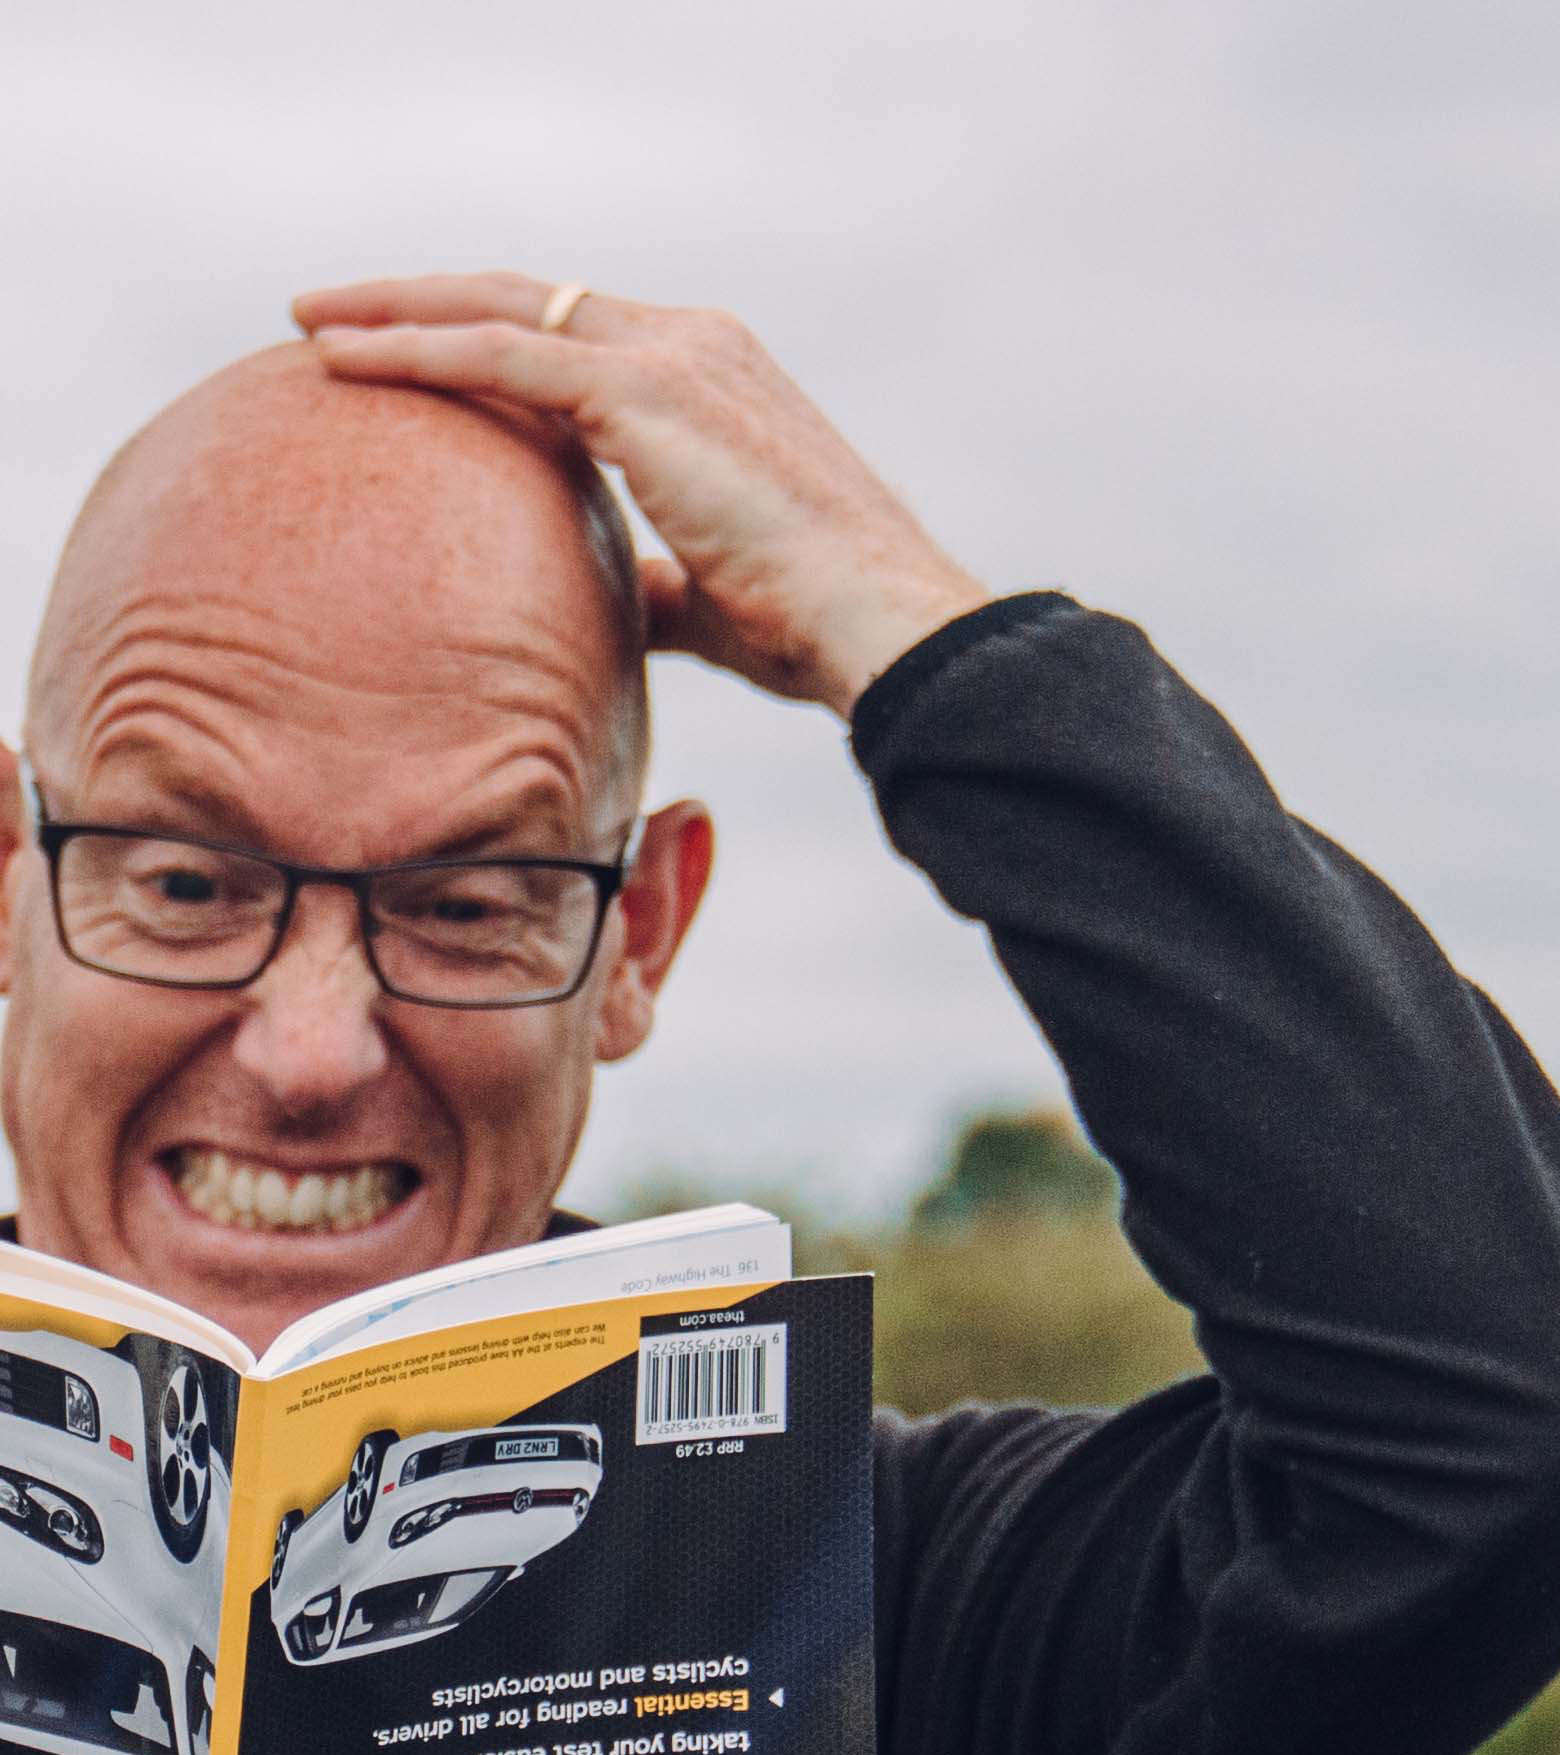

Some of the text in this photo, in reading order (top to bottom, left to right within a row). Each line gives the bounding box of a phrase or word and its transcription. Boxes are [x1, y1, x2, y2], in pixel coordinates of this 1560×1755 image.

[620, 1259, 758, 1295] 136 The Highway Code
[679, 1310, 744, 1328] theaa.com
[553, 1328, 572, 1339] also
[574, 1325, 590, 1335] can
[593, 1323, 606, 1333] We
[482, 1336, 509, 1350] driving
[512, 1335, 530, 1346] with
[532, 1331, 551, 1343] help
[590, 1335, 605, 1345] The
[772, 1332, 780, 1345] 9
[543, 1343, 552, 1352] at
[555, 1337, 587, 1350] experts
[431, 1351, 446, 1361] and
[449, 1344, 479, 1357] lessons
[491, 1350, 509, 1361] have
[512, 1349, 524, 1357] AA
[527, 1345, 540, 1355] the
[392, 1361, 402, 1370] on
[404, 1354, 429, 1366] advice
[448, 1353, 487, 1370] produced
[365, 1362, 390, 1377] buying
[410, 1365, 429, 1377] book
[431, 1362, 446, 1373] this
[349, 1372, 363, 1383] and
[364, 1377, 377, 1388] you
[379, 1373, 396, 1384] help
[399, 1372, 407, 1381] to
[321, 1376, 347, 1390] running
[345, 1381, 362, 1393] pass
[327, 1387, 343, 1400] your
[302, 1394, 325, 1409] driving
[753, 1413, 778, 1425] ISBN
[495, 1440, 556, 1458] LRN2 DRV
[675, 1439, 744, 1458] RRP £2.49
[431, 1657, 749, 1708] cyclists and motorcyclists
[372, 1689, 750, 1747] Essential reading for all drivers,
[672, 1730, 750, 1755] taking
